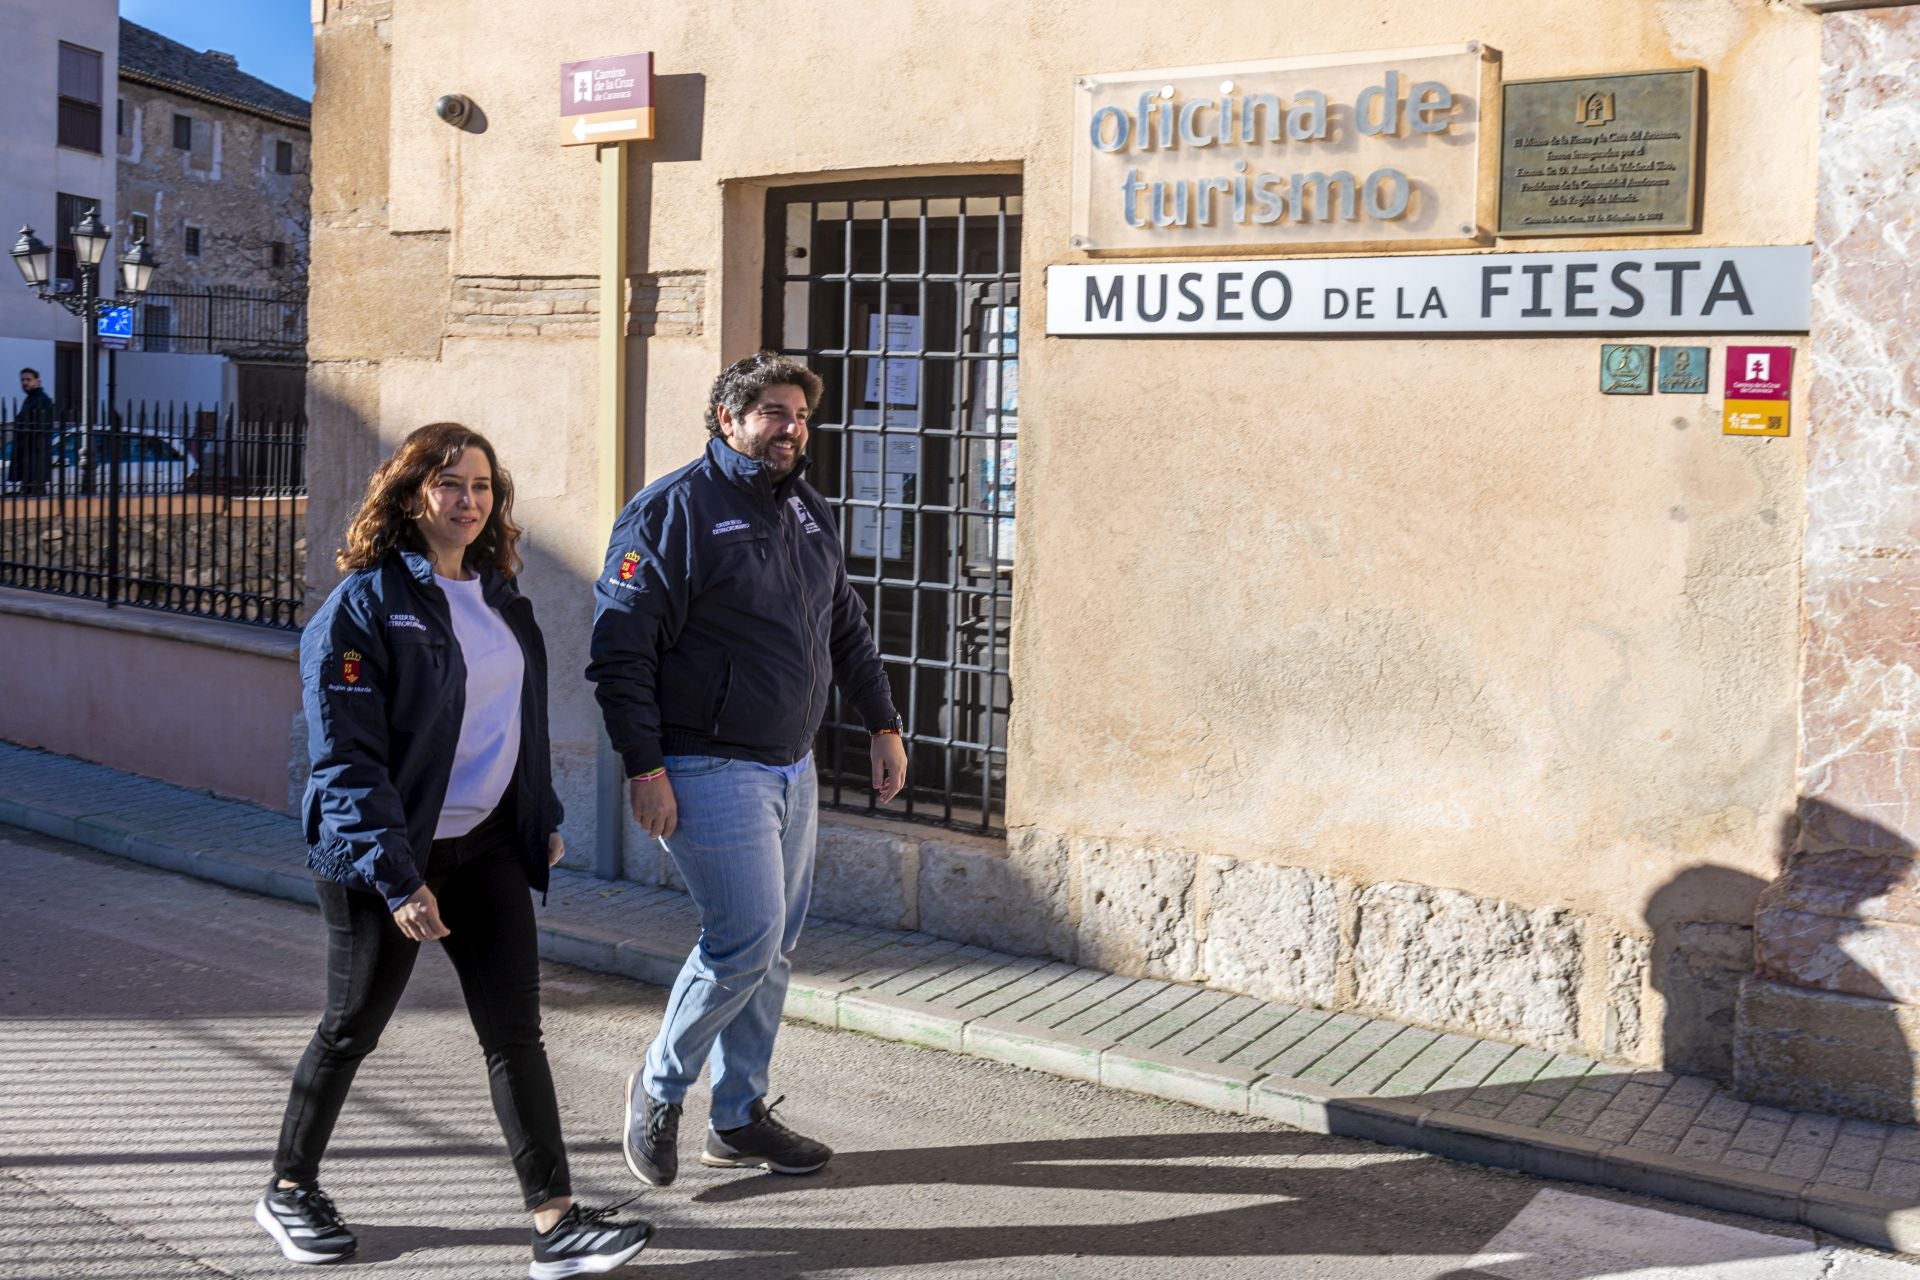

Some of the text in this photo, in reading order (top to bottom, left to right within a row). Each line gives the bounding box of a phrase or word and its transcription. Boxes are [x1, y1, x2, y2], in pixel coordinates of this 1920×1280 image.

[1089, 69, 1453, 153] oficina de
[1120, 159, 1410, 229] turismo
[1084, 260, 1754, 323] MUSEO DE LA FIESTA
